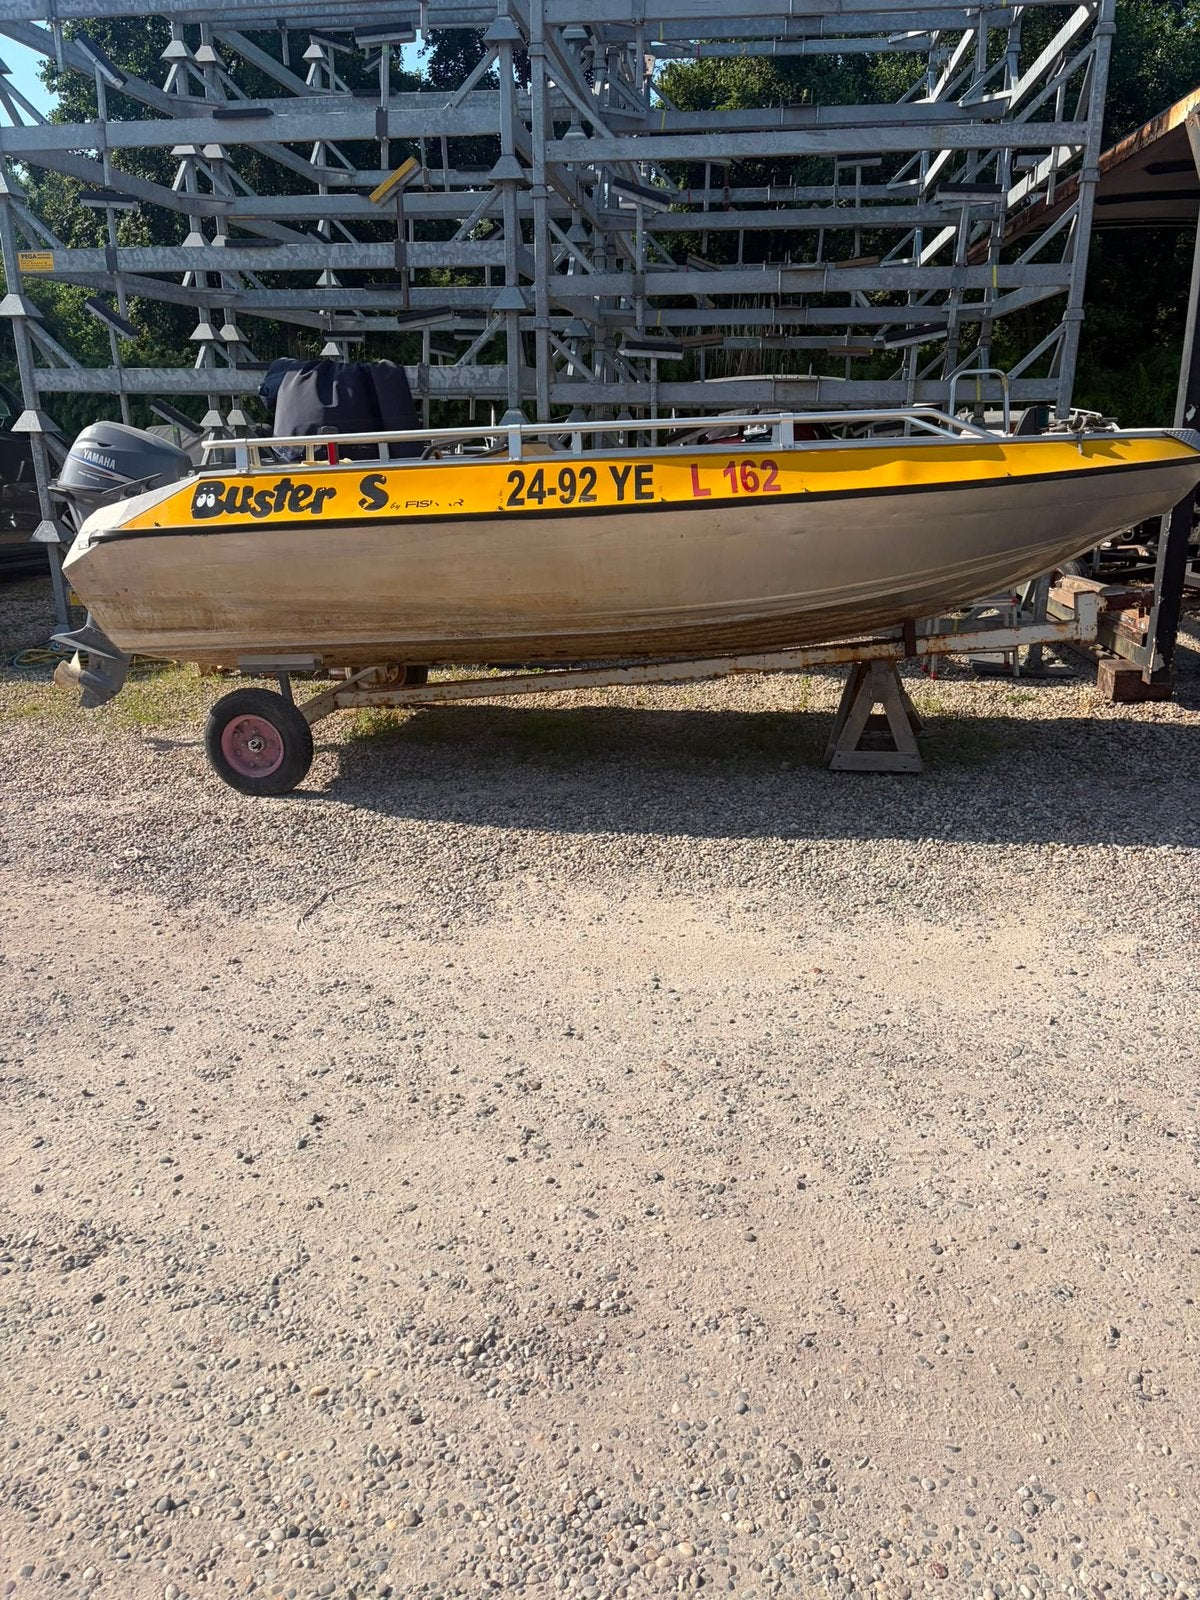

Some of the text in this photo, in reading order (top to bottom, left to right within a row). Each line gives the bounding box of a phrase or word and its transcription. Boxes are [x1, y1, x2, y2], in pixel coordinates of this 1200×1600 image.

[83, 449, 116, 470] YAMAHA
[691, 459, 782, 497] L 162
[191, 473, 389, 519] Buster S
[507, 464, 655, 506] 24-92 YE
